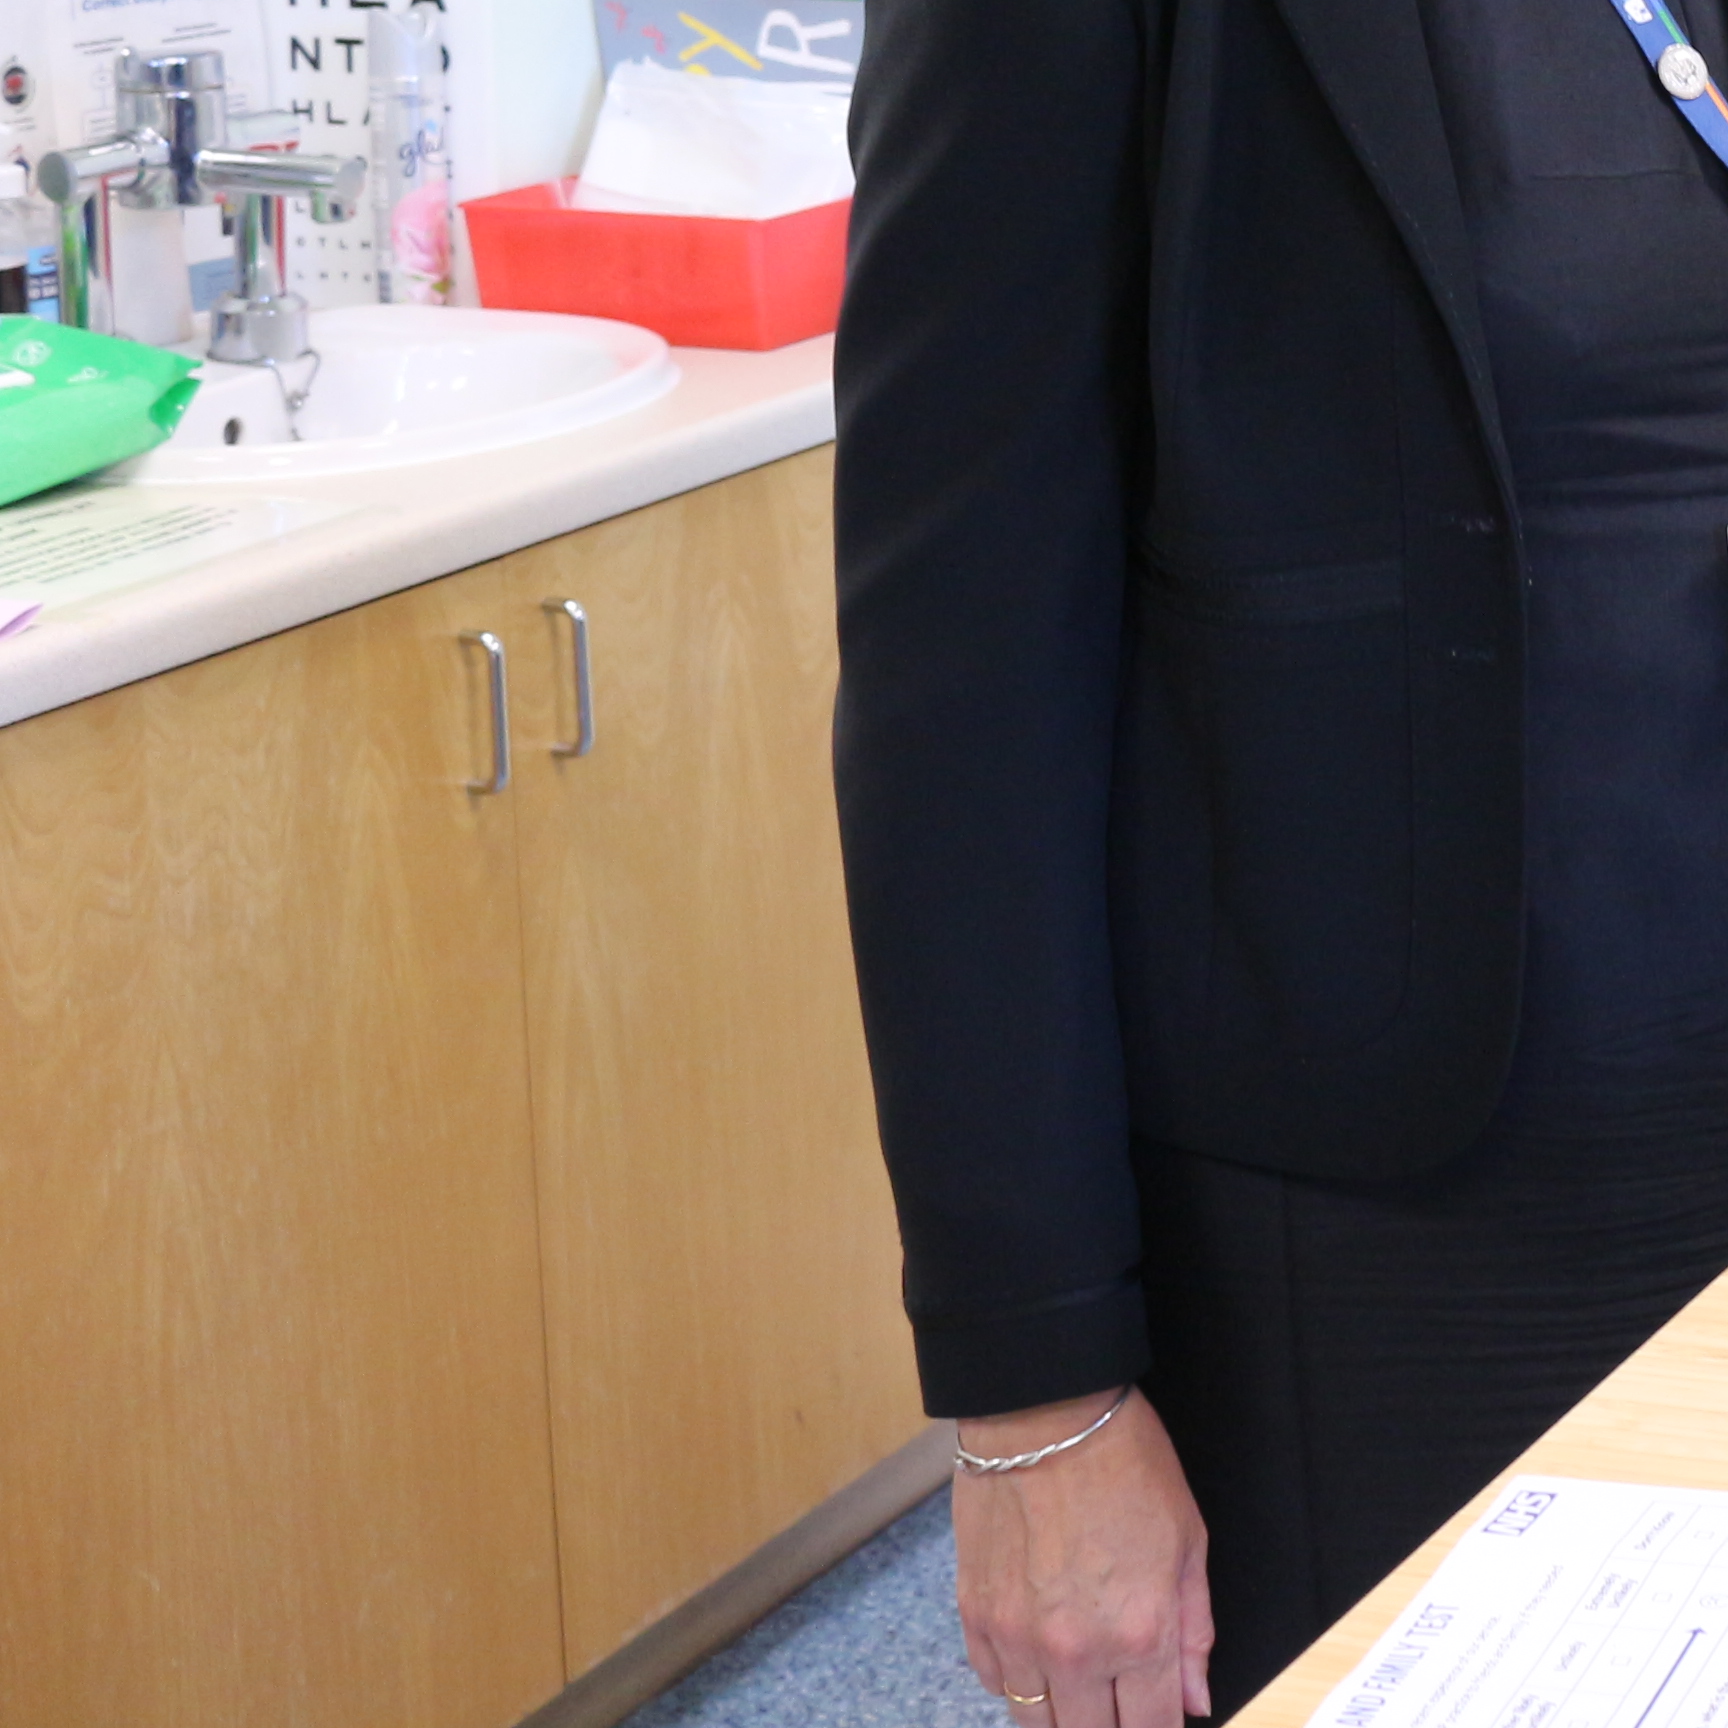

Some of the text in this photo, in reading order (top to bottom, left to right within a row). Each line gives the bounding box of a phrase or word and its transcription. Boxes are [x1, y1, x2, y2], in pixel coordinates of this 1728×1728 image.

[1485, 1490, 1554, 1535] NHS
[1335, 1602, 1460, 1728] AND FAMILY TEST
